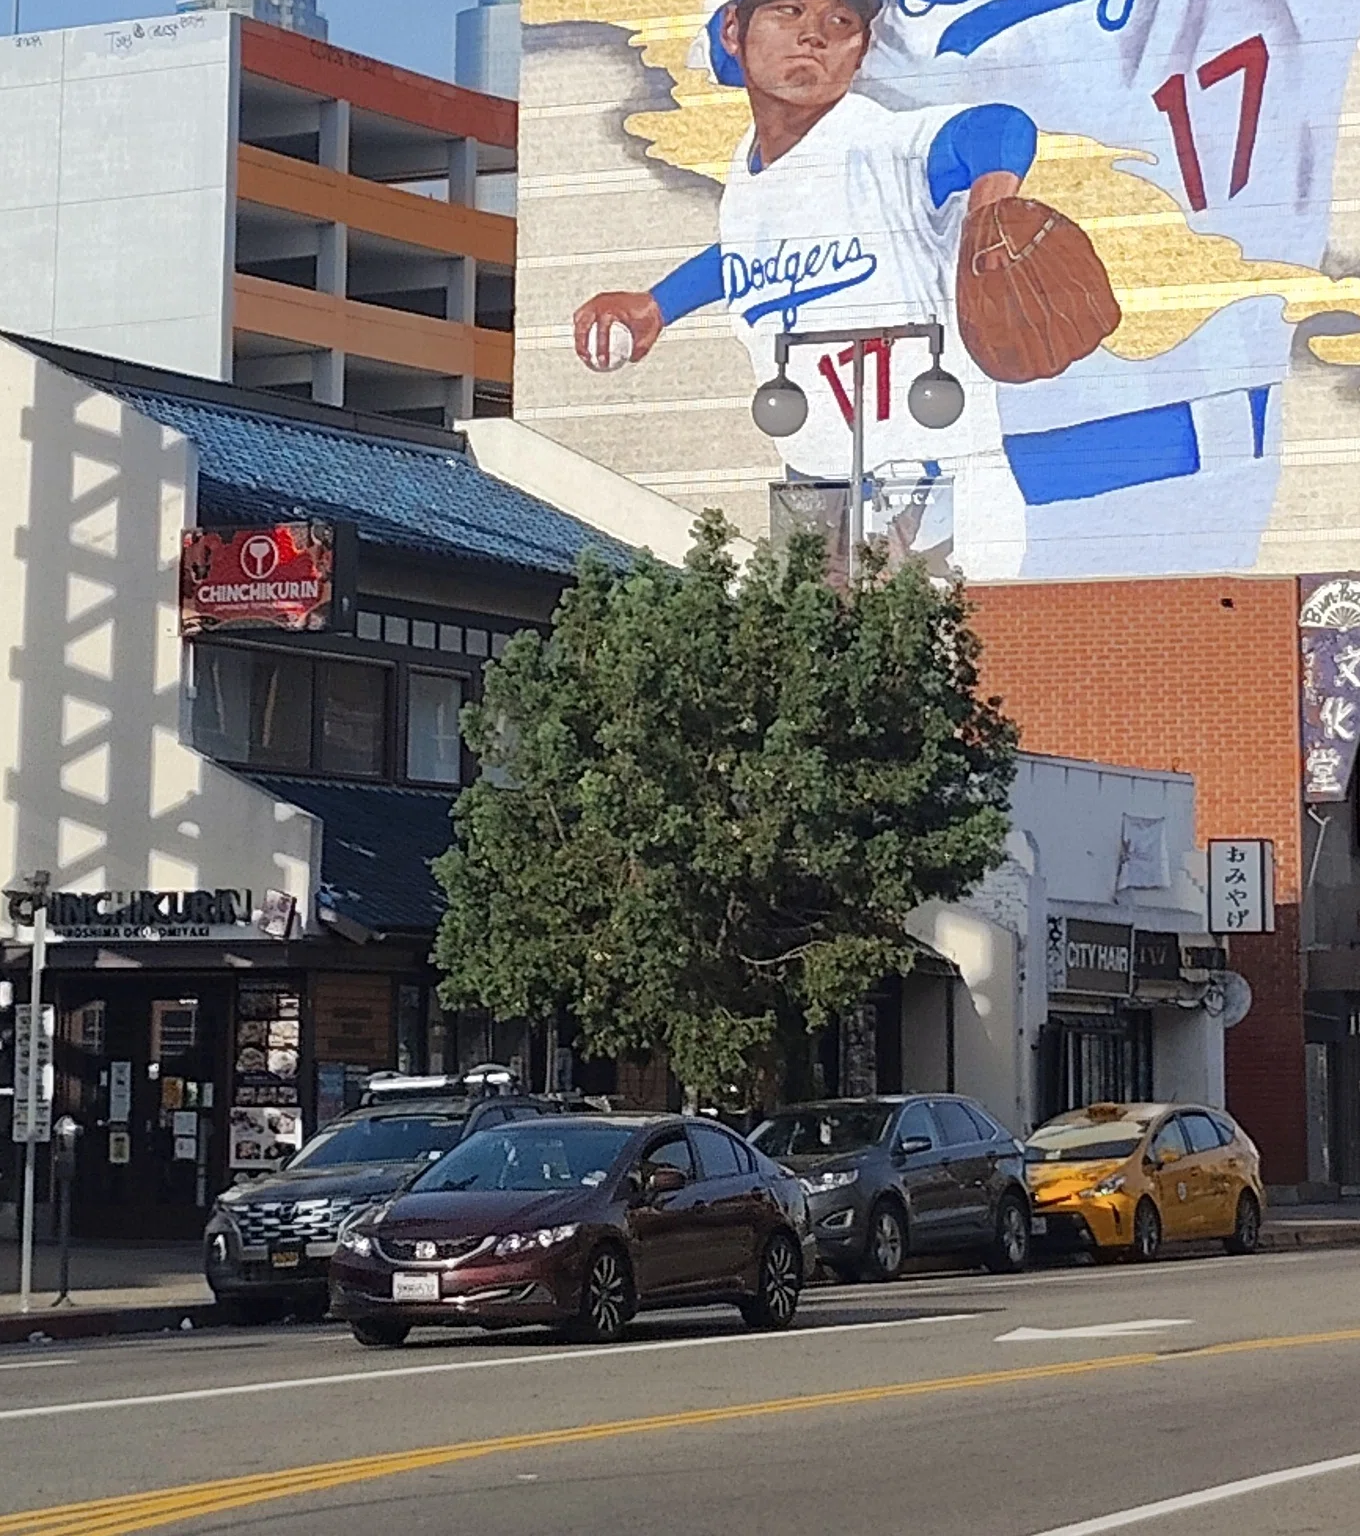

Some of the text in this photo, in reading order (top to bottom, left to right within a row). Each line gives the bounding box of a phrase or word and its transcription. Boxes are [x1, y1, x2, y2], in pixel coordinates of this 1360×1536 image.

[1151, 32, 1270, 212] 17
[721, 237, 865, 332] Dodgers
[817, 336, 891, 432] 17
[198, 579, 319, 604] CHINCHIKURIN
[8, 888, 252, 926] CINCHIKURIN
[1224, 845, 1250, 930] おみやげ
[1066, 941, 1097, 969] CITY
[1098, 944, 1129, 973] HAIR
